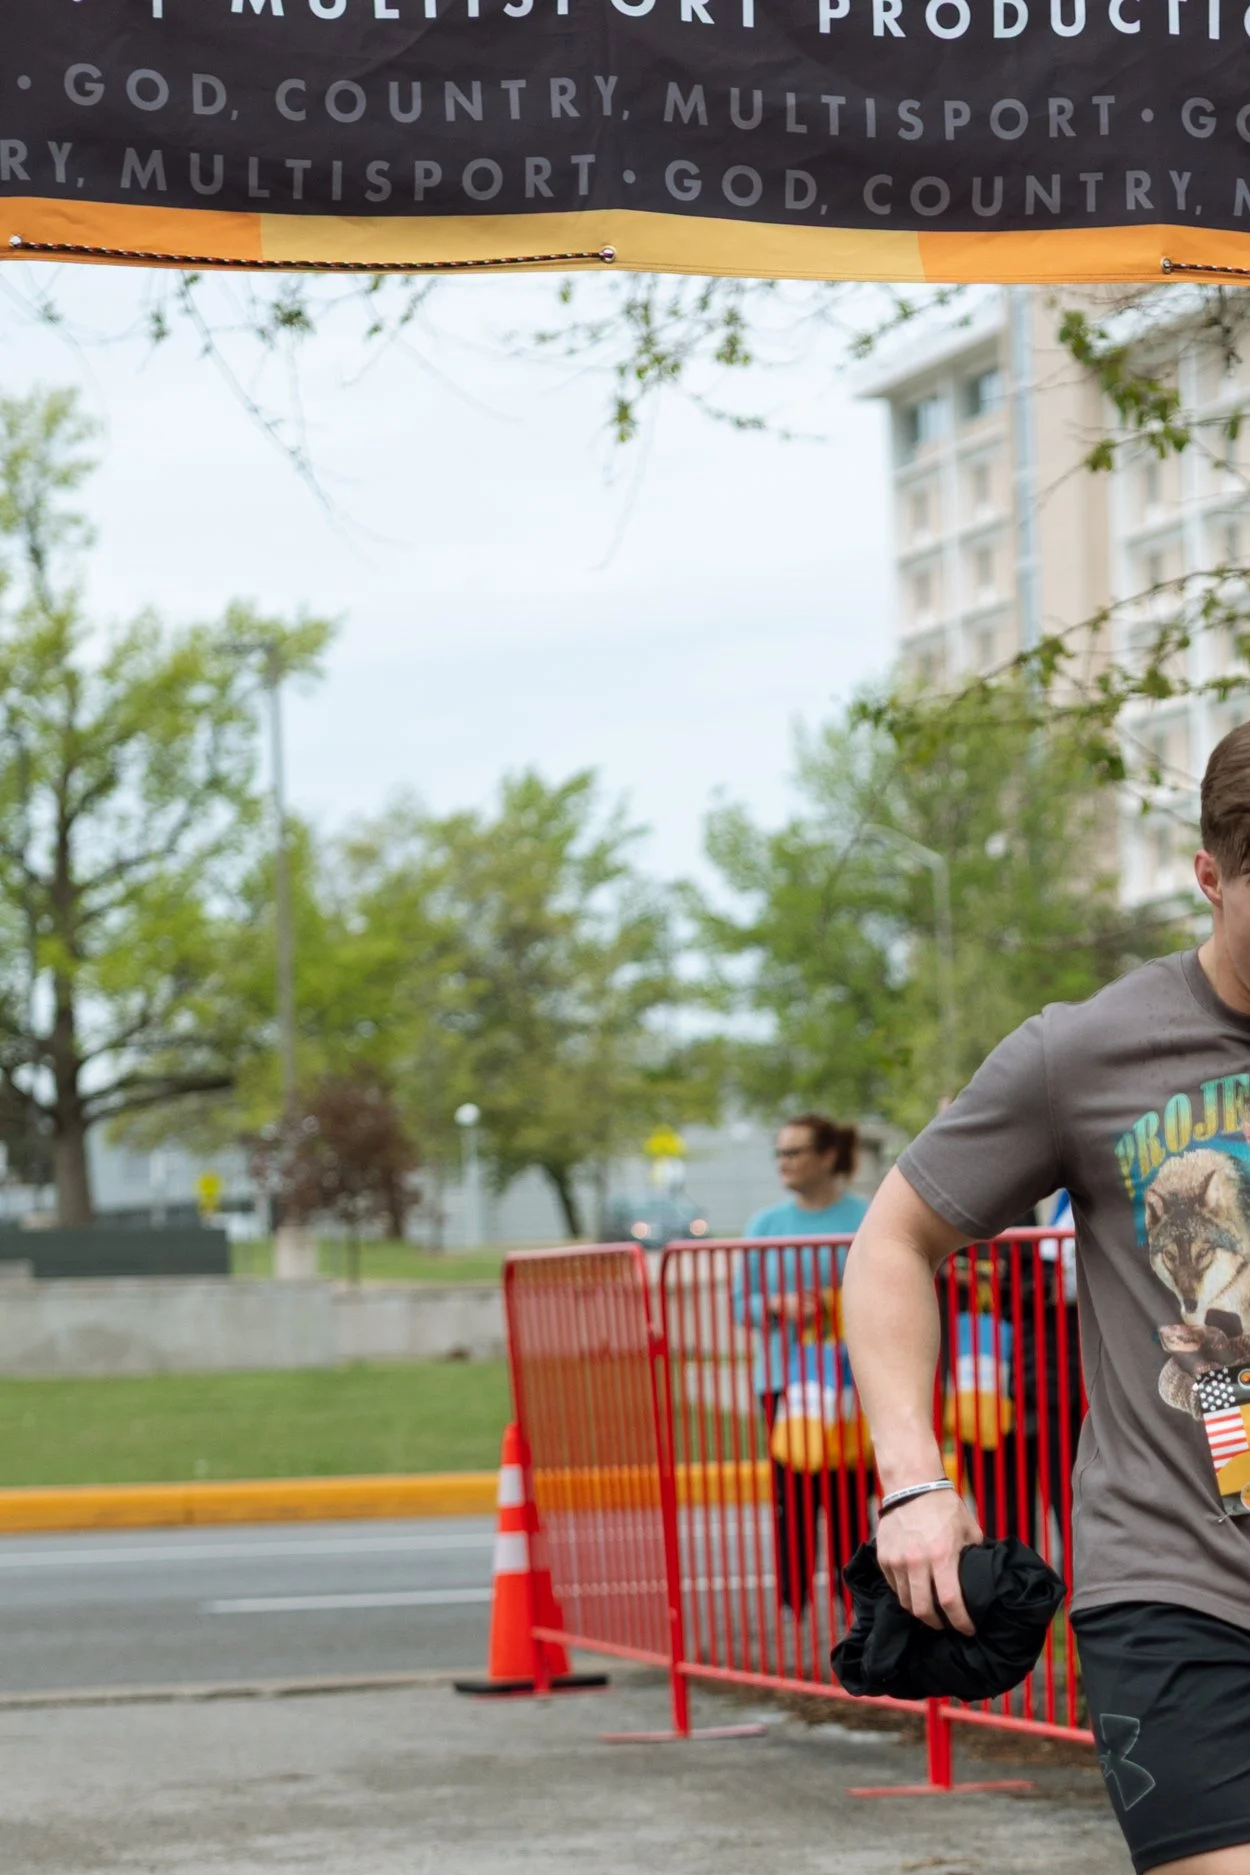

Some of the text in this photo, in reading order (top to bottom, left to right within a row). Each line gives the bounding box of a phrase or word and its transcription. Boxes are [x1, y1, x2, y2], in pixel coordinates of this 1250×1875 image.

[64, 63, 238, 121] GOD,
[275, 75, 630, 124] COUNTRY,
[664, 82, 1116, 141] MULTISPORT
[120, 147, 596, 202] MULTISPORT
[664, 159, 827, 215] GOD,
[863, 170, 1202, 217] COUNTRY,
